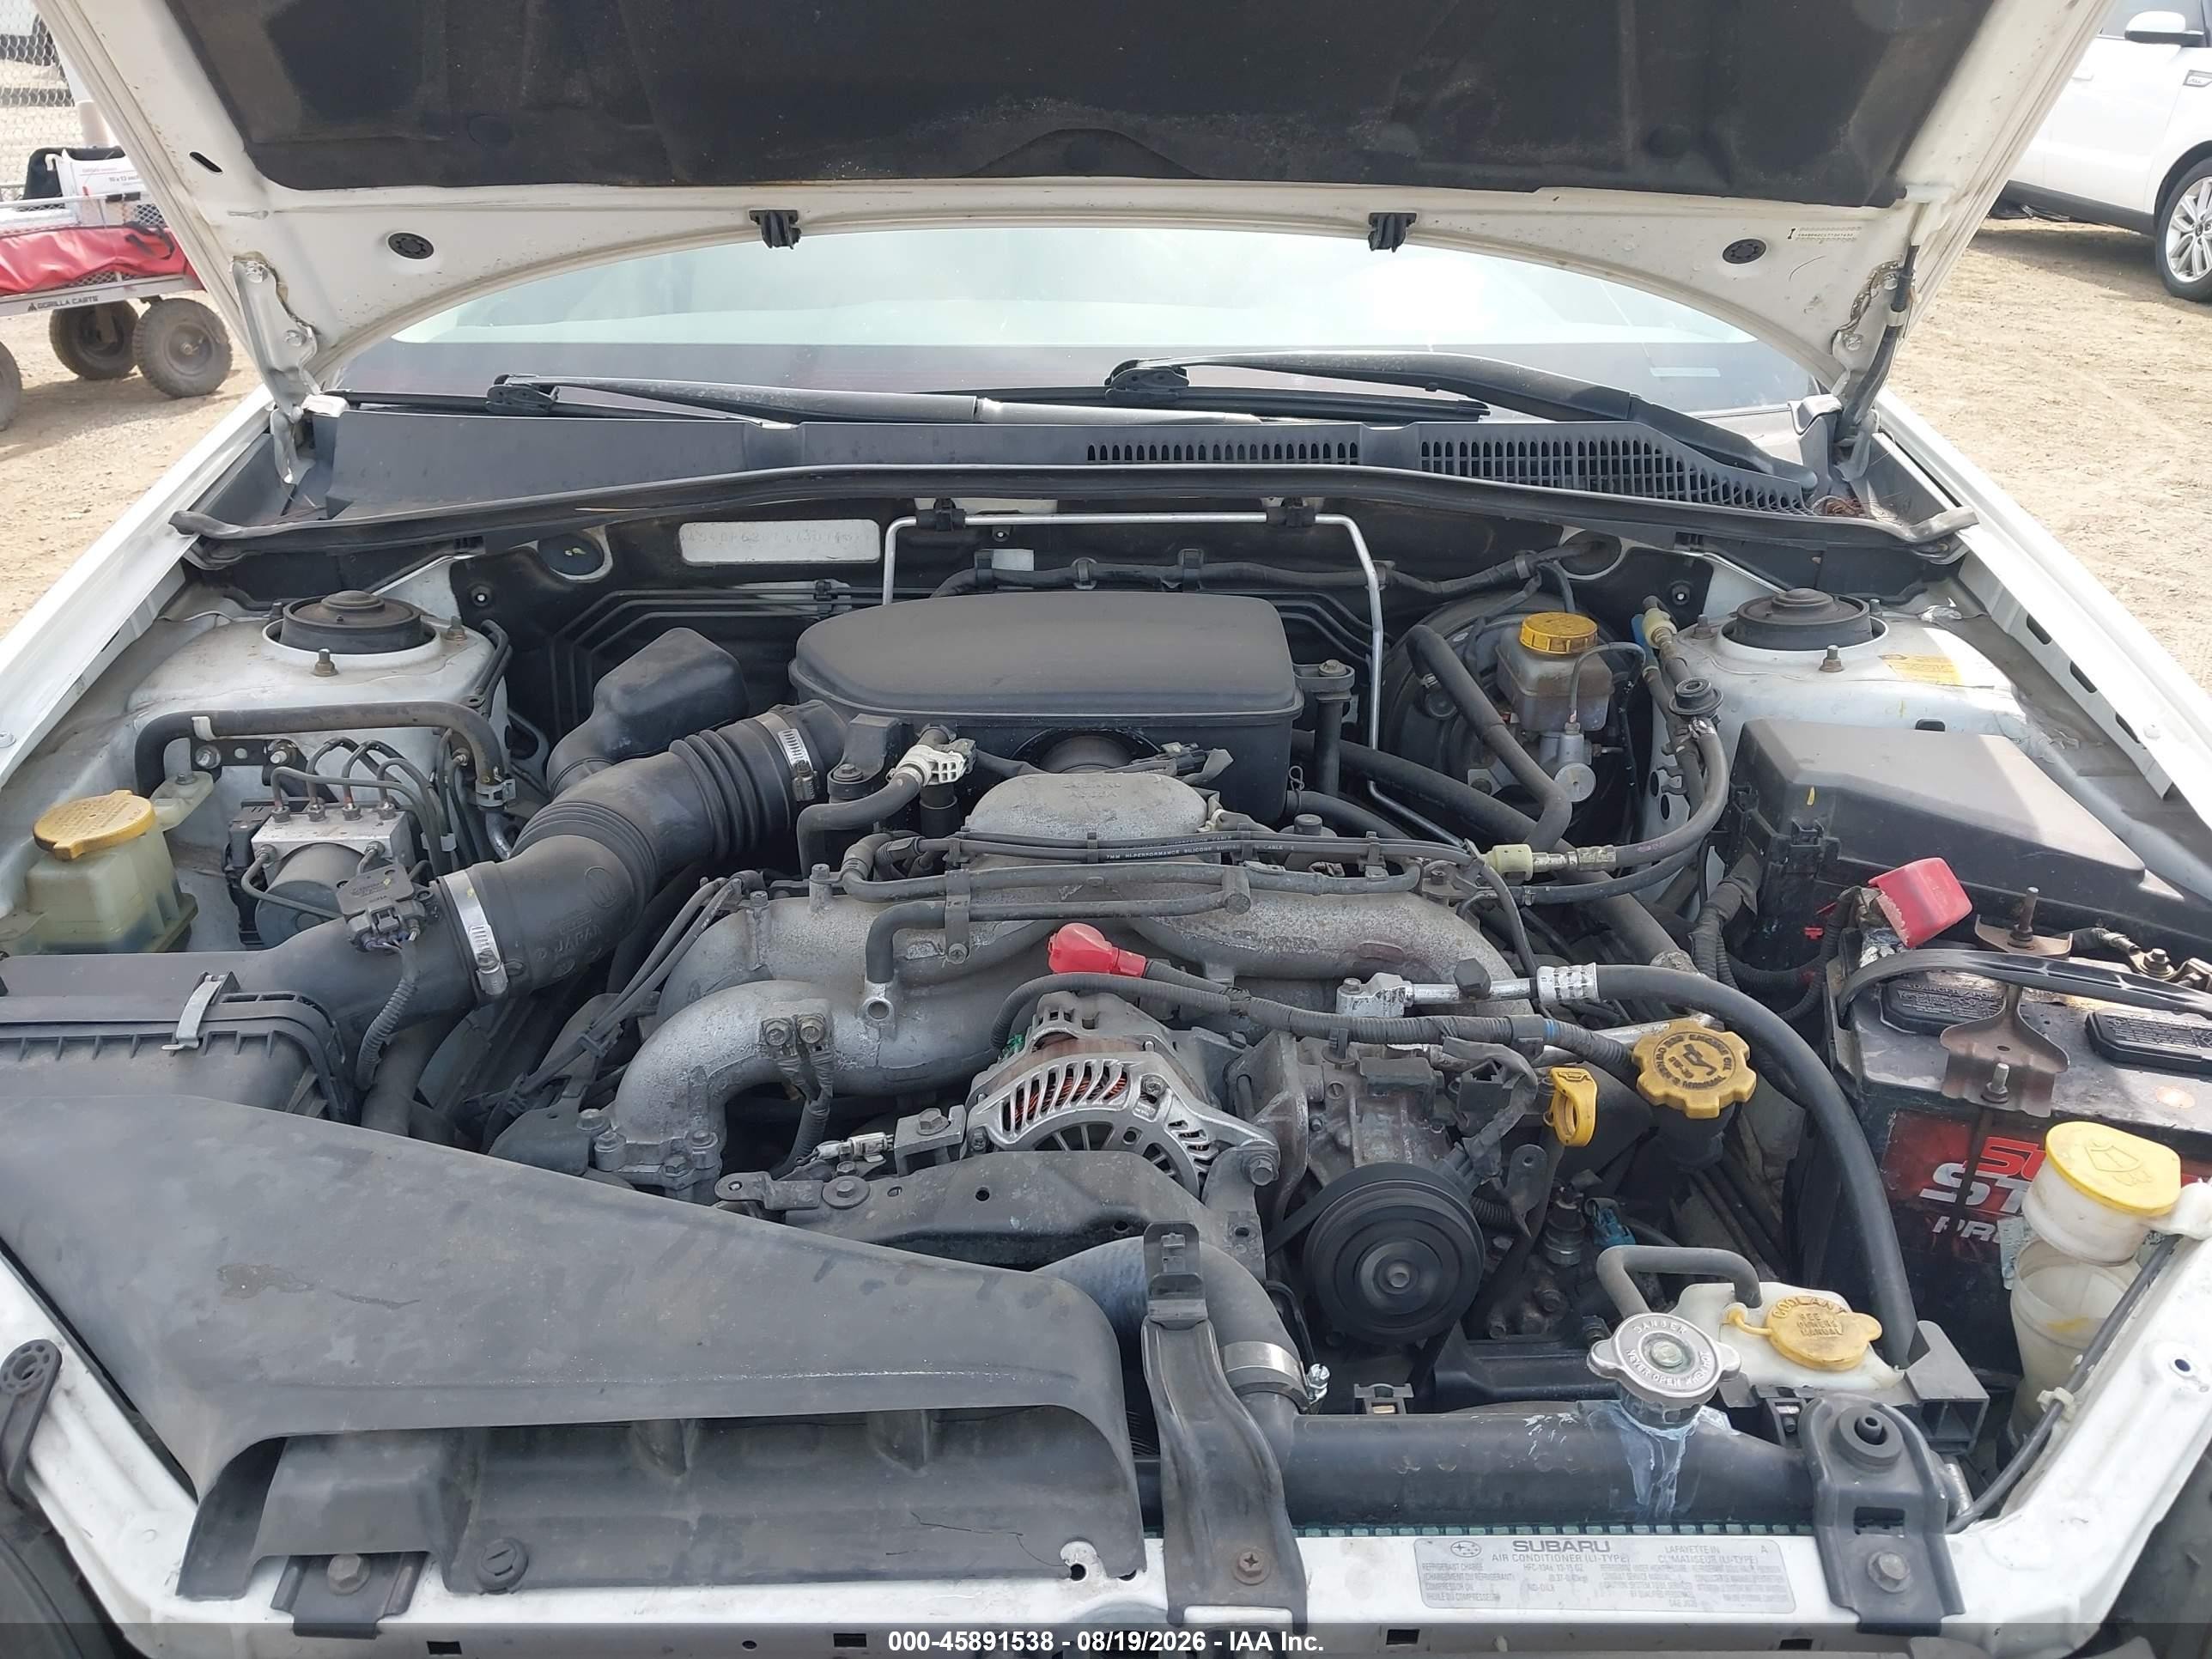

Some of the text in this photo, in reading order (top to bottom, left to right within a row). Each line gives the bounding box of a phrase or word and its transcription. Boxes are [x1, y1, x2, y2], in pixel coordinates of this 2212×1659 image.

[37, 300, 70, 310] GORILLA
[1633, 1319, 1687, 1334] DANGER
[1626, 1348, 1652, 1377] NEVER
[1652, 1372, 1682, 1389] OPEN
[1512, 1540, 1611, 1553] SUBARU
[1664, 1545, 1709, 1554] LAFAYETTE
[1760, 1545, 1769, 1554] A
[1492, 1553, 1510, 1563] AIR
[1511, 1553, 1583, 1563] CONDITIONER
